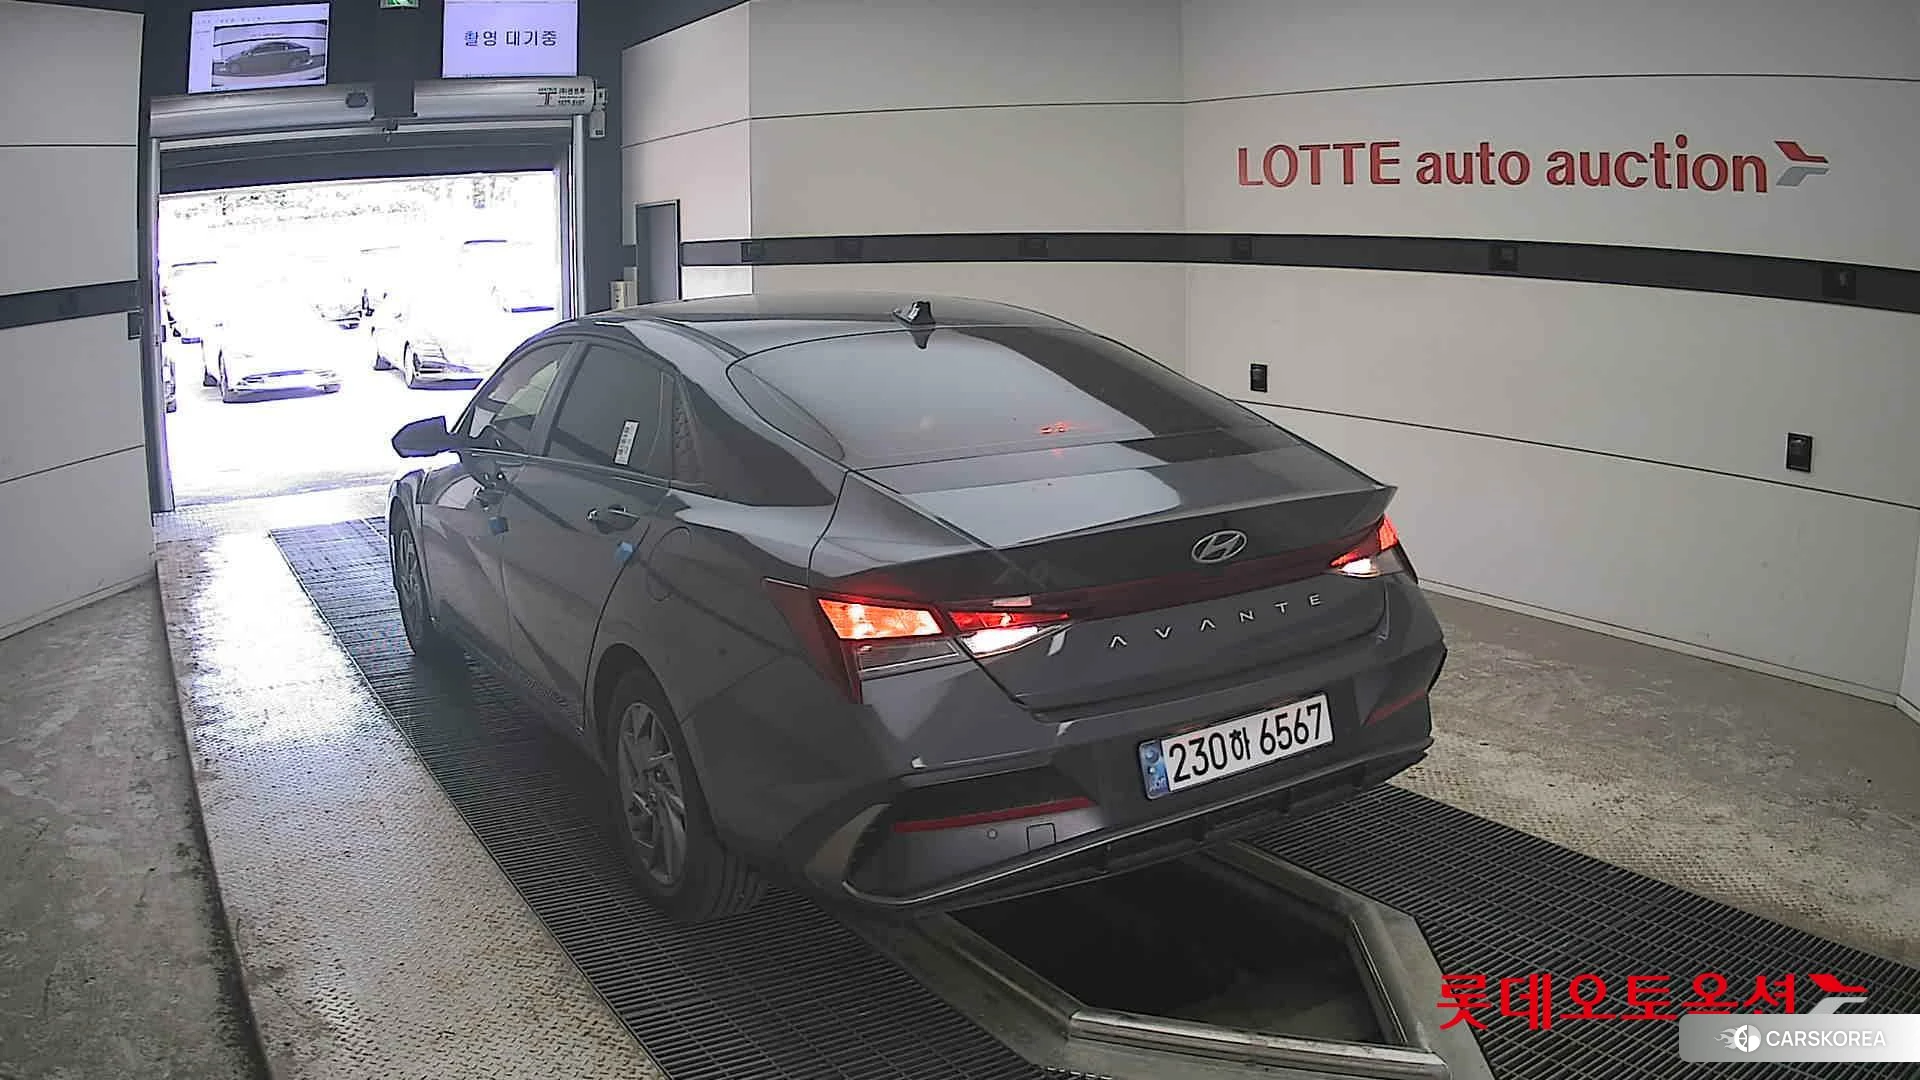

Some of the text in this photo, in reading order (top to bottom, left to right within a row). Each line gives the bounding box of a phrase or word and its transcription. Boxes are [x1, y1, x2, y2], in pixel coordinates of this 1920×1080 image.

[506, 30, 557, 47] 대기중
[1237, 135, 1768, 193] LOTTE auto auction
[1109, 592, 1322, 649] AVANTE
[1168, 702, 1323, 784] 230하 6567
